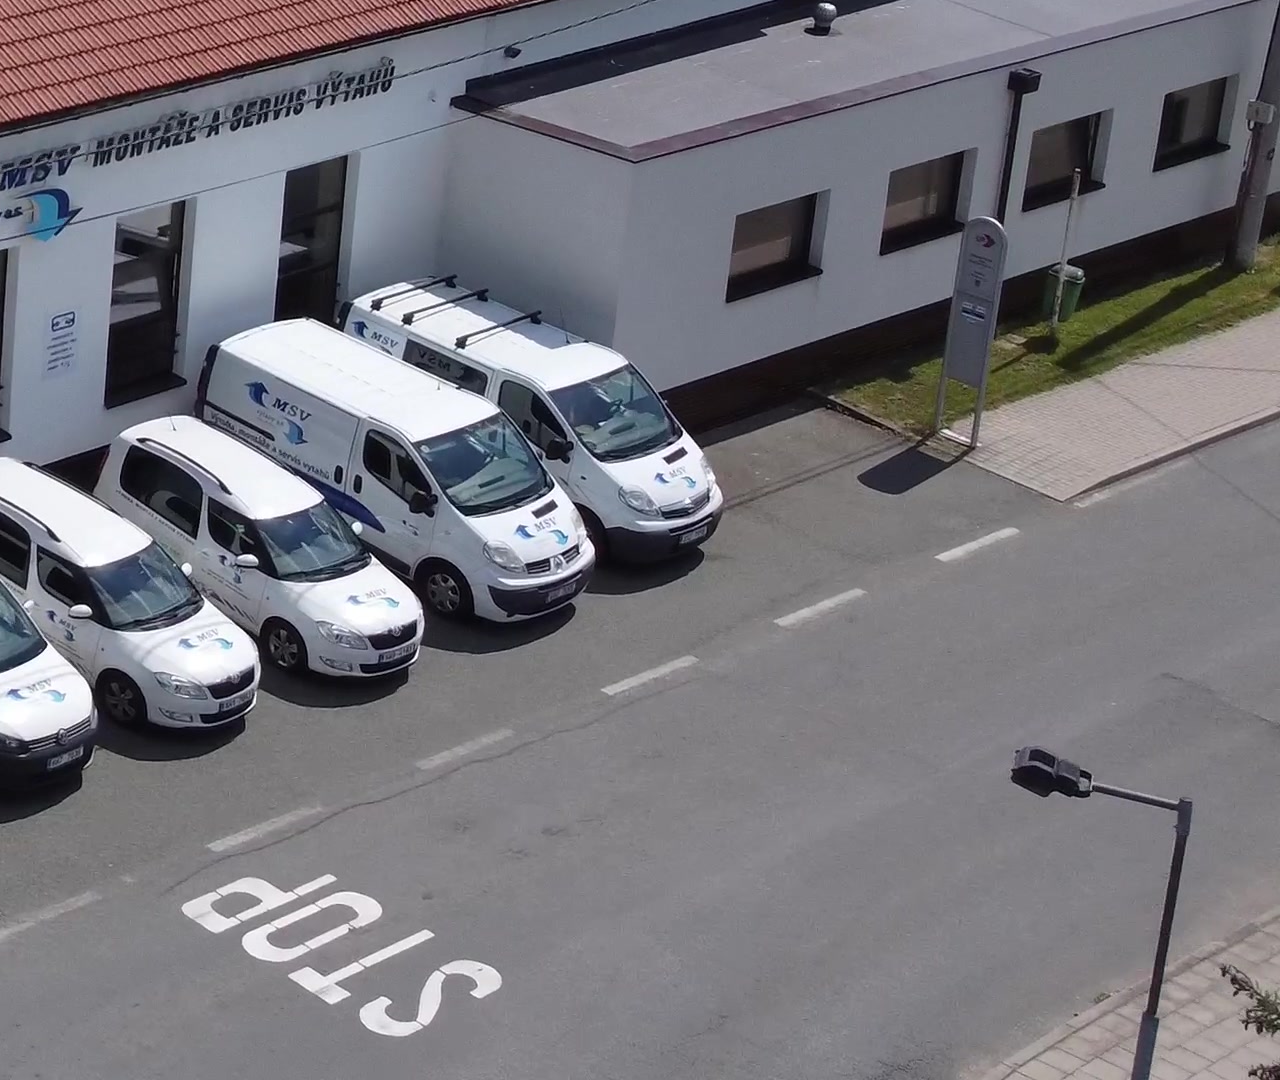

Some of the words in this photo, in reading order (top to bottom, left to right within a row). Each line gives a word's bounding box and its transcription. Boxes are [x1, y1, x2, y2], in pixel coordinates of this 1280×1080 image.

[92, 110, 200, 167] MONTÁŽE
[206, 109, 222, 138] A
[229, 87, 308, 132] SERVIS
[314, 57, 396, 110] VÝTAHŮ
[370, 331, 399, 349] MSV
[271, 398, 313, 422] MSV
[534, 516, 557, 532] MSV
[365, 588, 387, 599] MSV
[58, 618, 78, 631] MSV
[196, 628, 220, 642] MSV
[26, 677, 53, 693] MSV
[181, 873, 503, 1038] STOP
